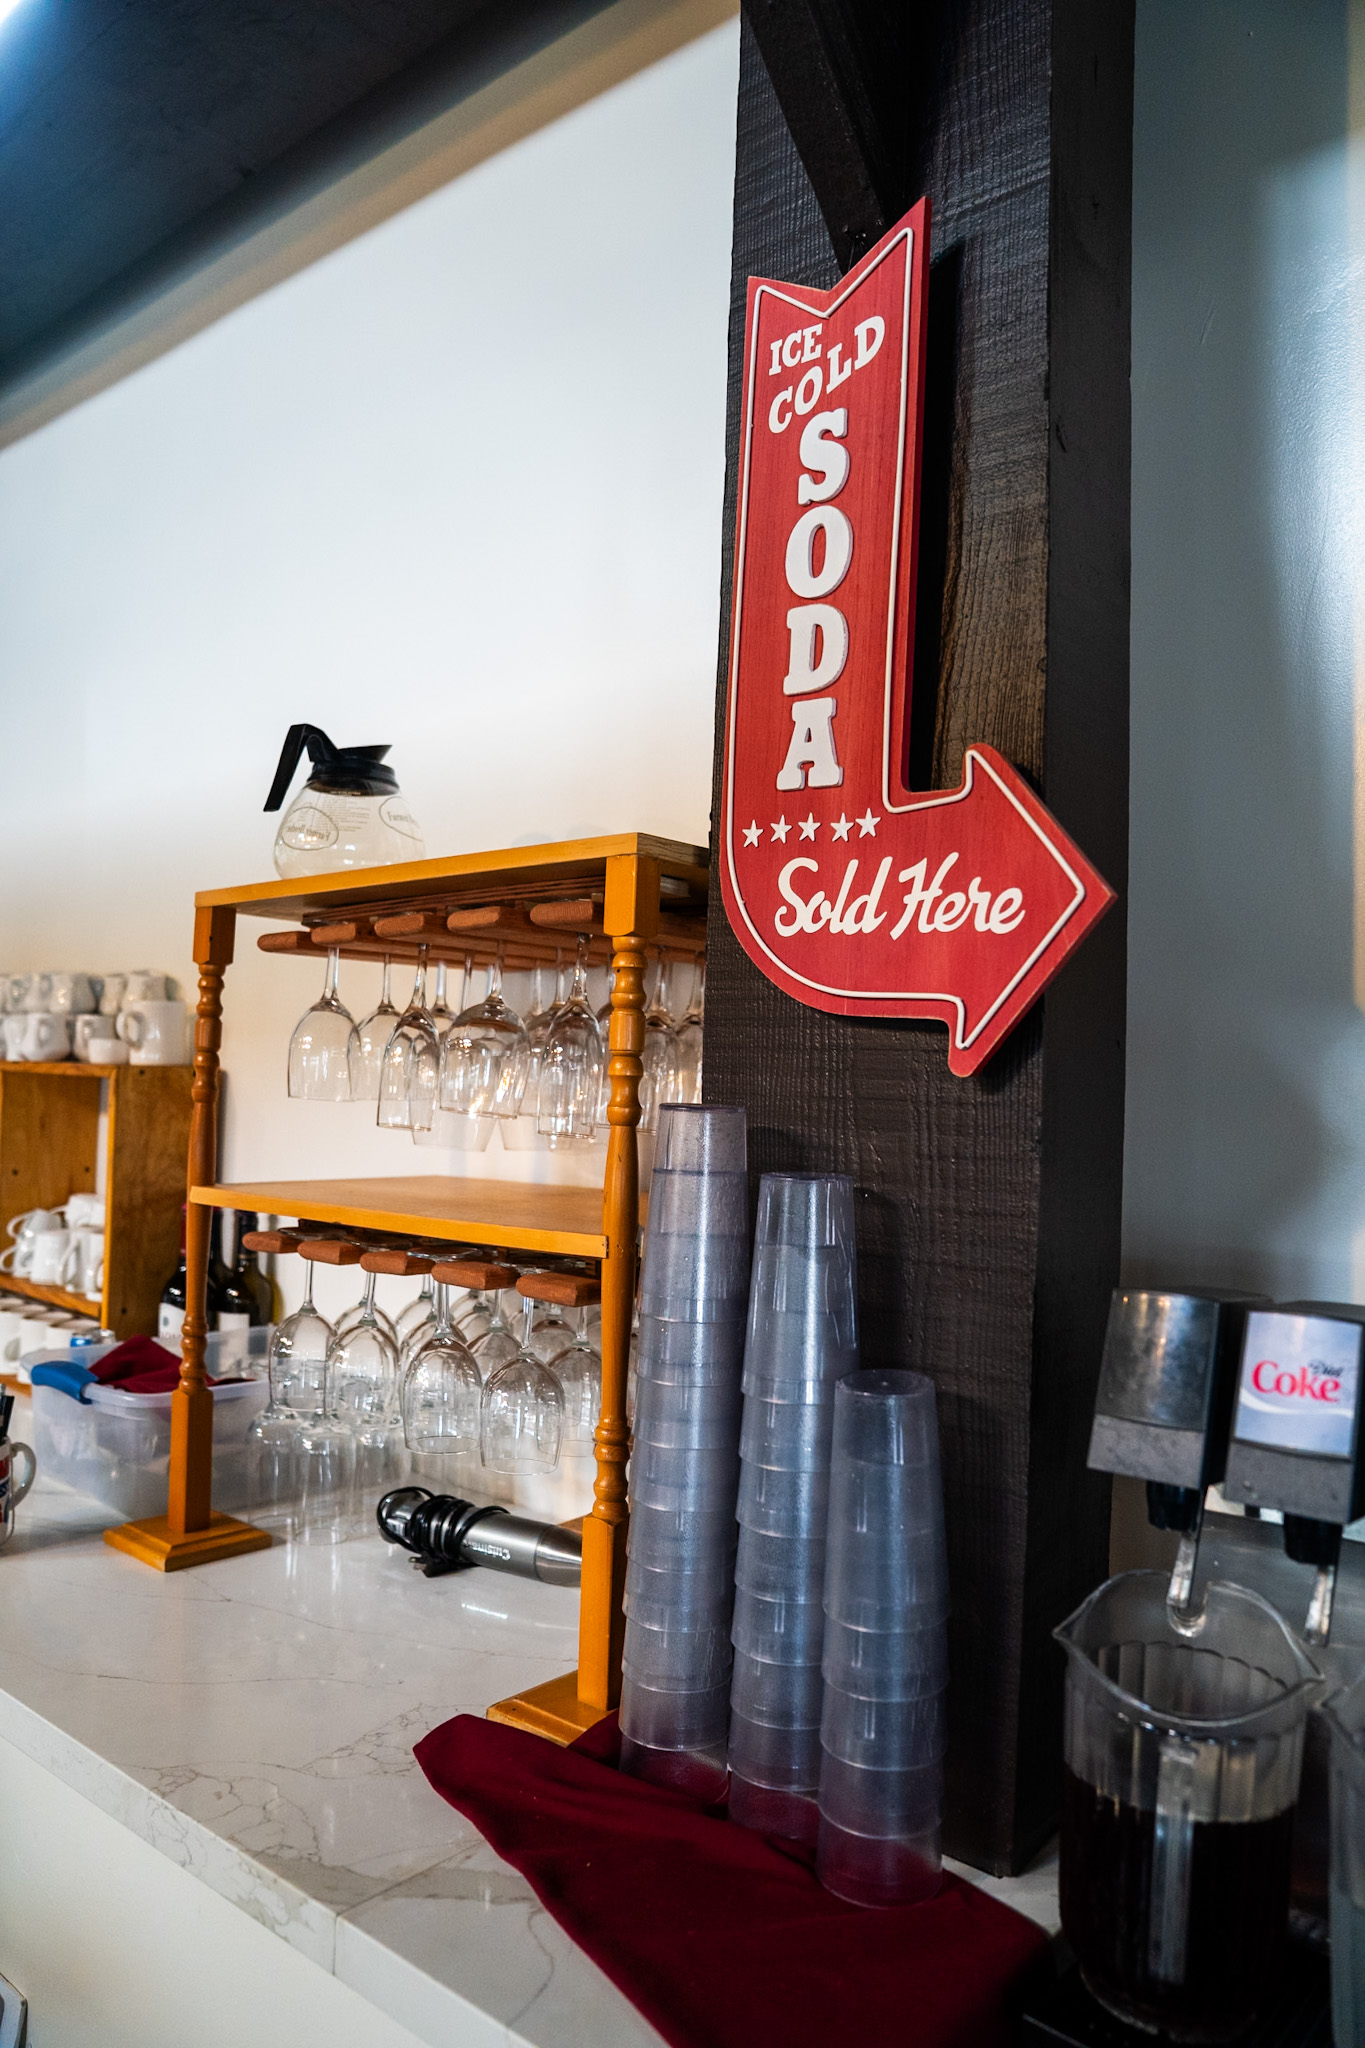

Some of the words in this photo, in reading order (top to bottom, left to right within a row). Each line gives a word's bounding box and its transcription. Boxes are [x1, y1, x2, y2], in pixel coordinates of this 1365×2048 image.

[768, 323, 823, 376] ICE
[768, 315, 886, 434] COLD
[776, 407, 854, 791] SODA
[774, 856, 893, 937] Sold
[889, 852, 1026, 941] Here
[1251, 1360, 1341, 1402] Coke
